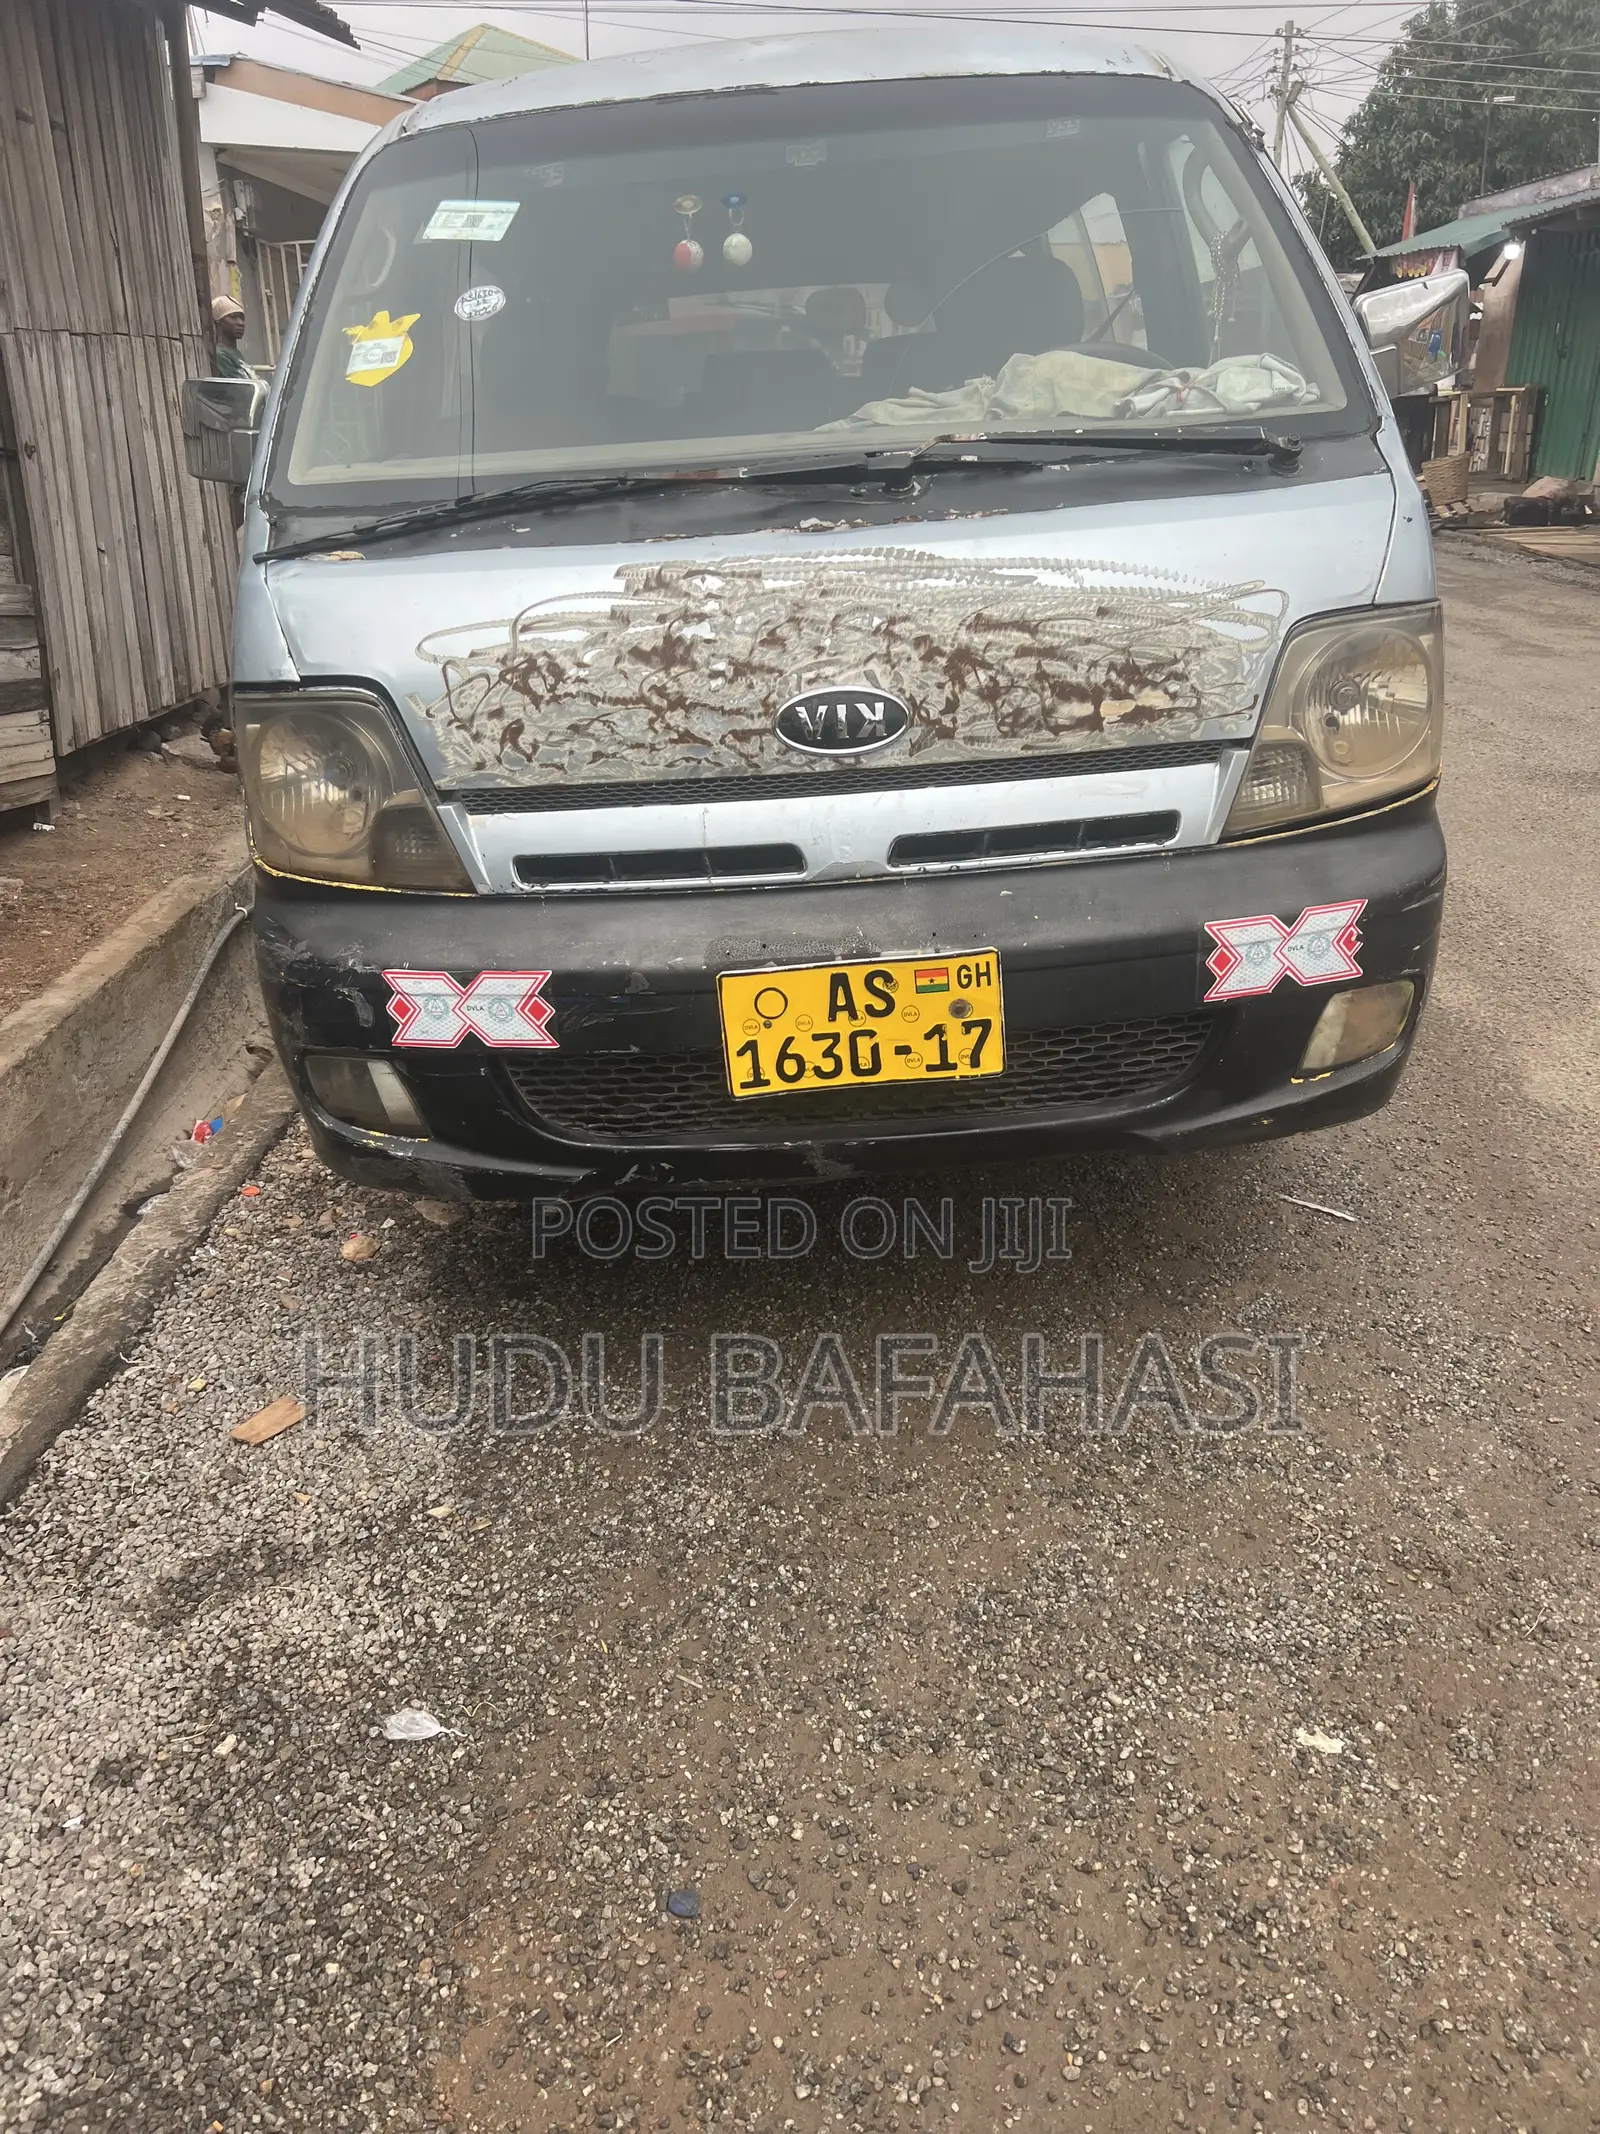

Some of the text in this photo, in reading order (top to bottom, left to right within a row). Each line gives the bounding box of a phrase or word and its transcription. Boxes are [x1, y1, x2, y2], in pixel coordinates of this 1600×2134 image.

[828, 961, 992, 1022] AS GH
[736, 1019, 993, 1089] 1630-17
